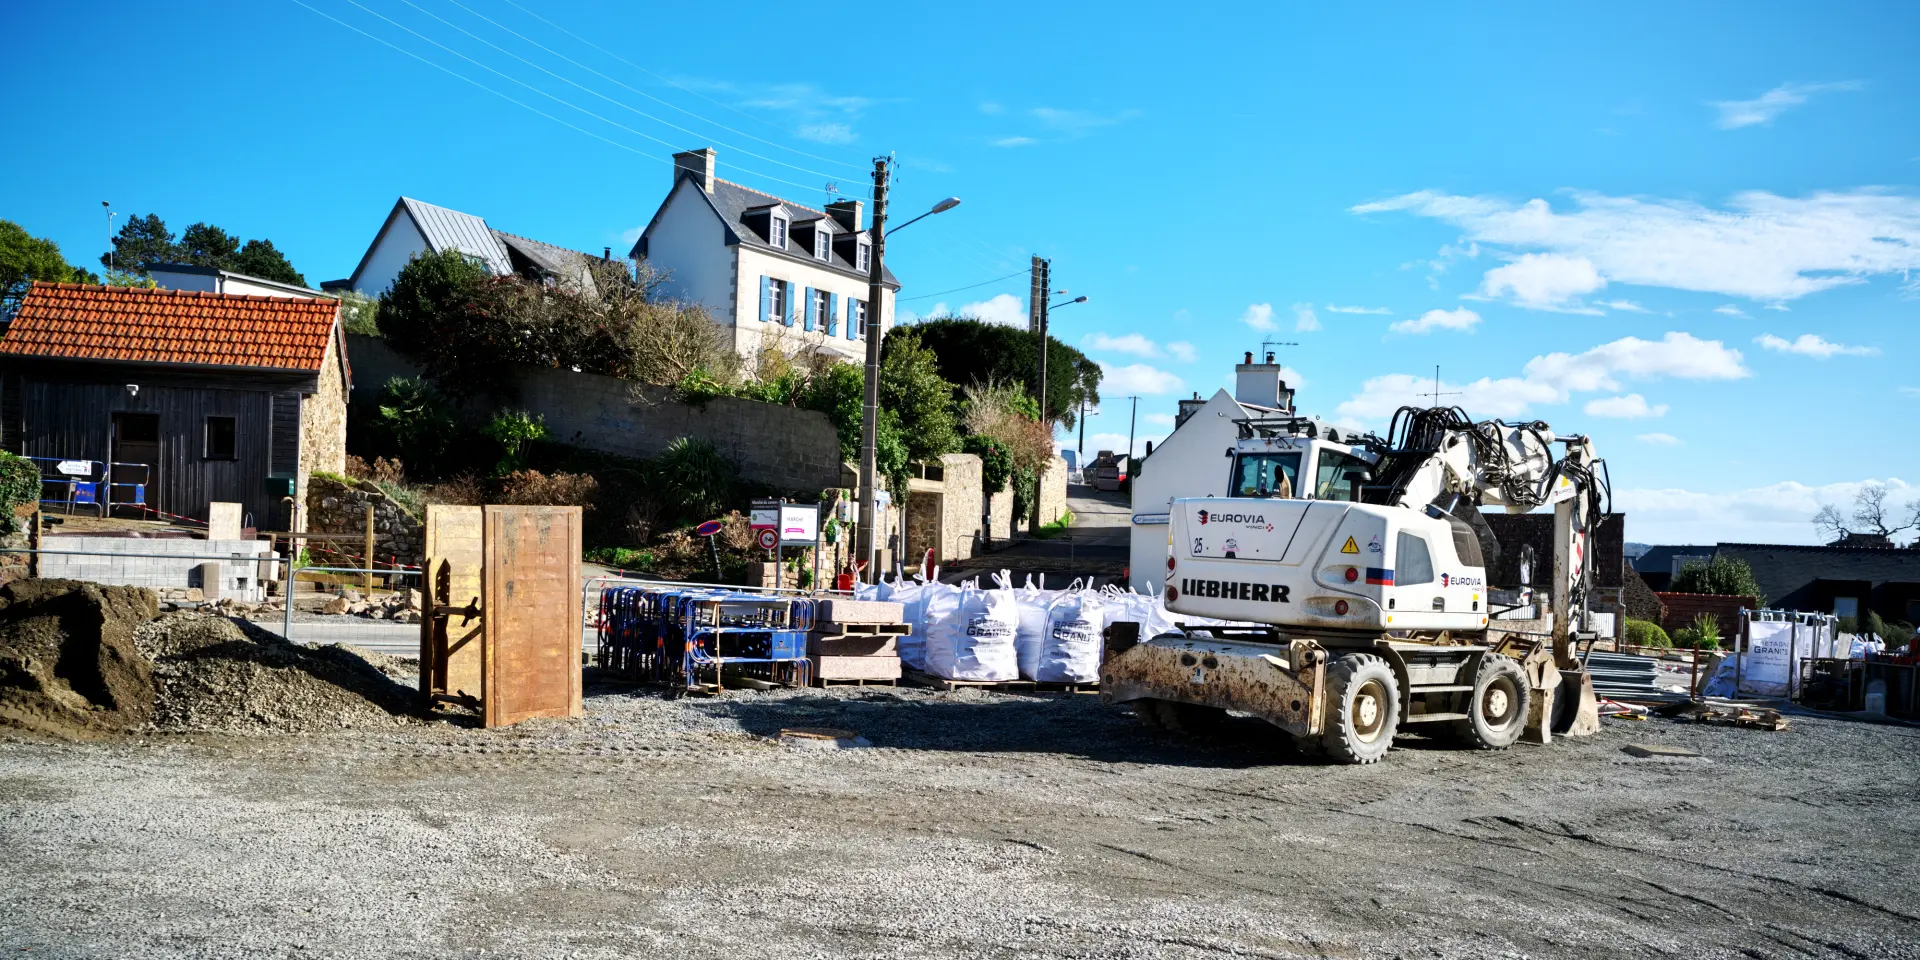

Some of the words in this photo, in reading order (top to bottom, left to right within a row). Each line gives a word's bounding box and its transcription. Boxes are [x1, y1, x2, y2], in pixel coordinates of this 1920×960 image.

[1210, 513, 1265, 524] EUROVIA
[1194, 538, 1203, 553] 25
[1450, 576, 1481, 586] EUROVIA
[1182, 578, 1290, 603] LIEBHERR
